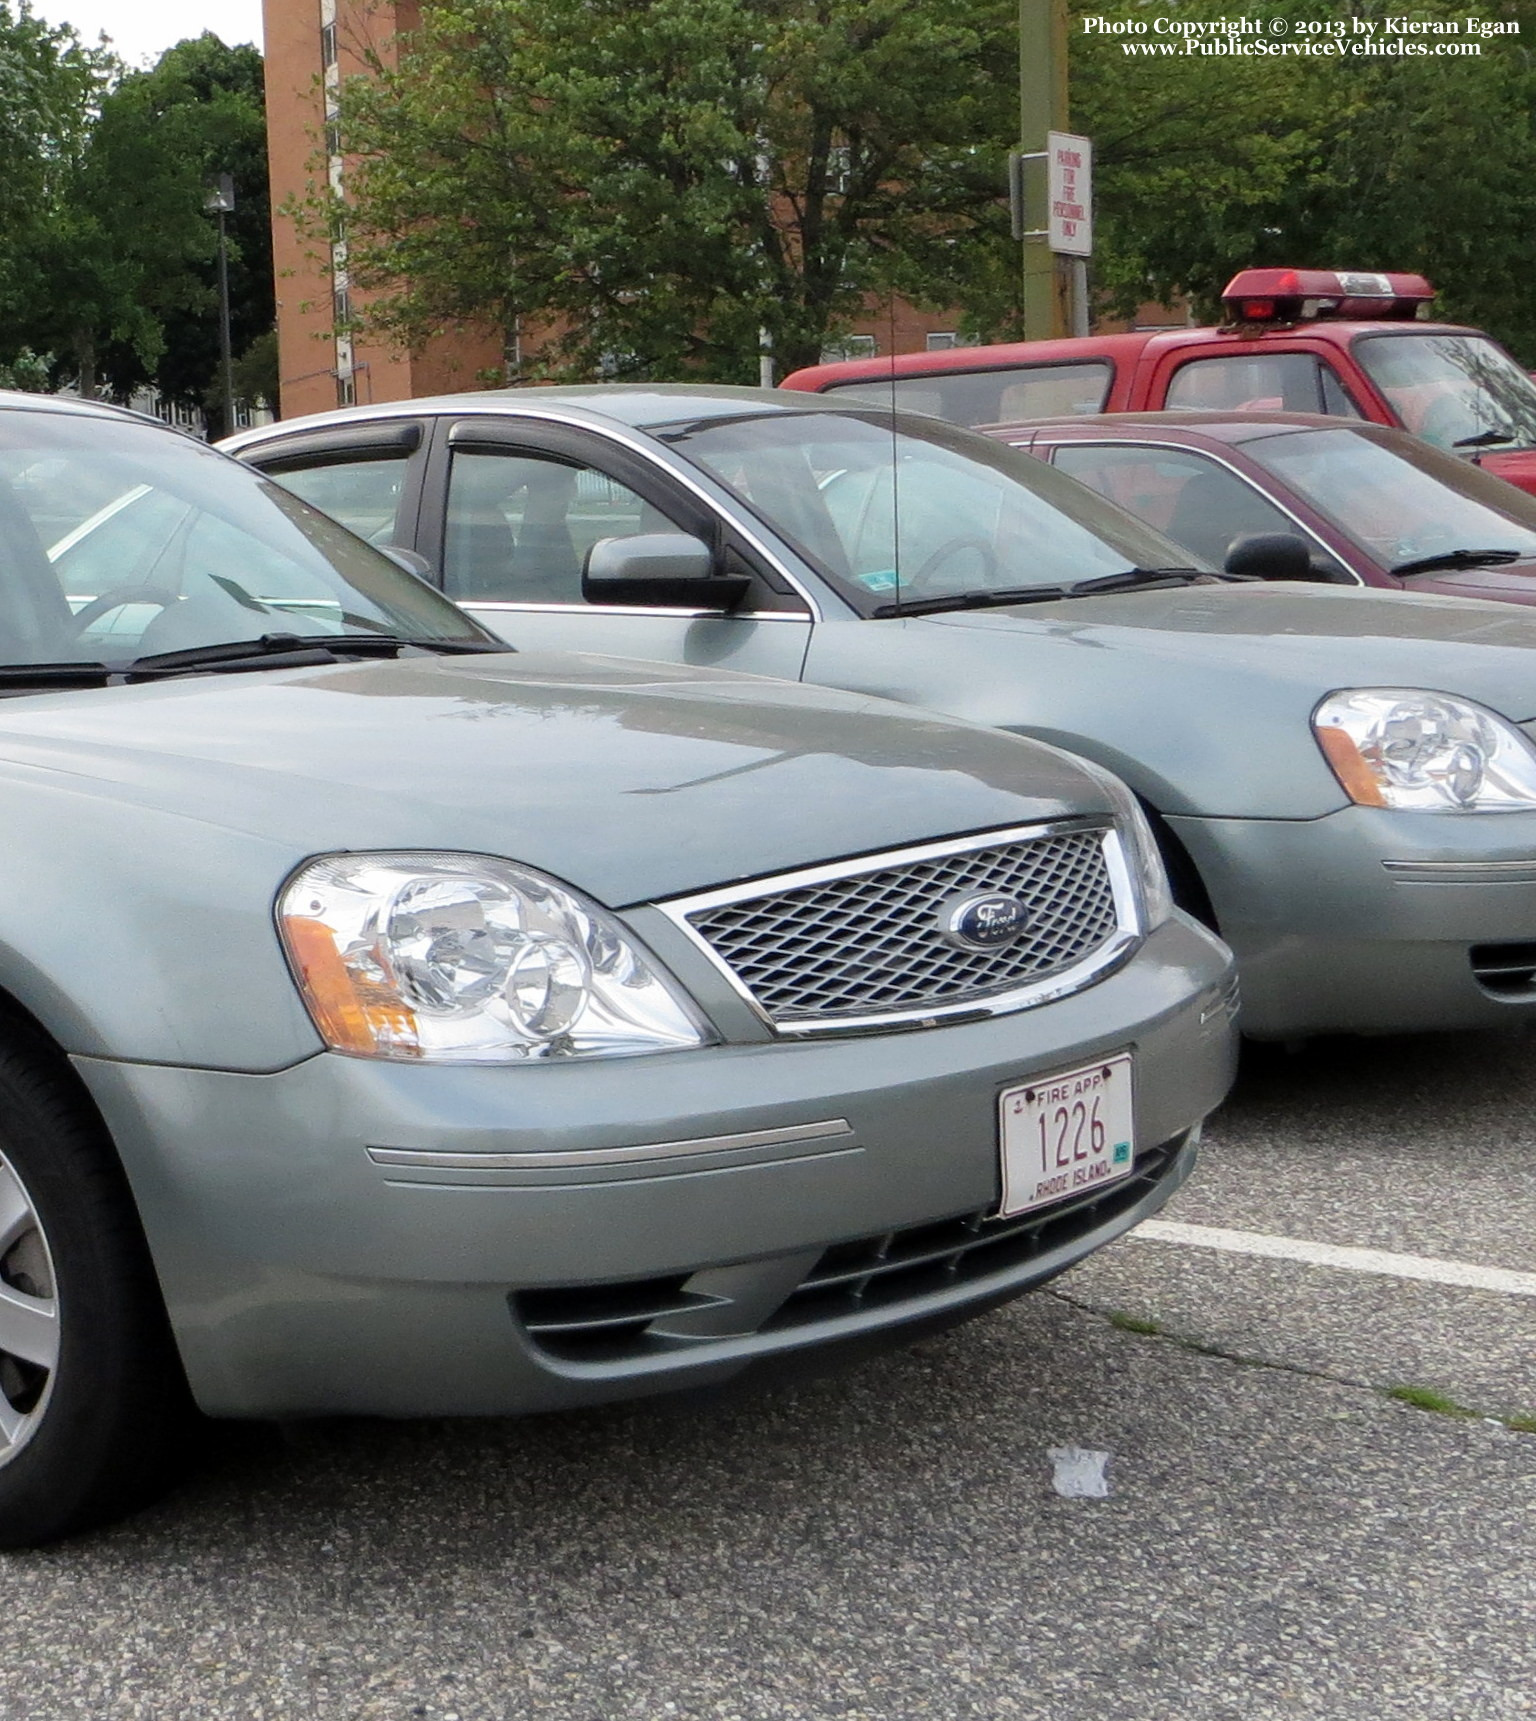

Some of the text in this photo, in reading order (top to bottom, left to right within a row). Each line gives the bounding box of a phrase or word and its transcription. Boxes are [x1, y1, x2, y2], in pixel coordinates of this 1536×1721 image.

[976, 902, 1017, 928] Ford
[1037, 1085, 1069, 1106] FIRE
[1039, 1096, 1105, 1172] 1226
[1036, 1160, 1107, 1198] RHODE ISLAND
